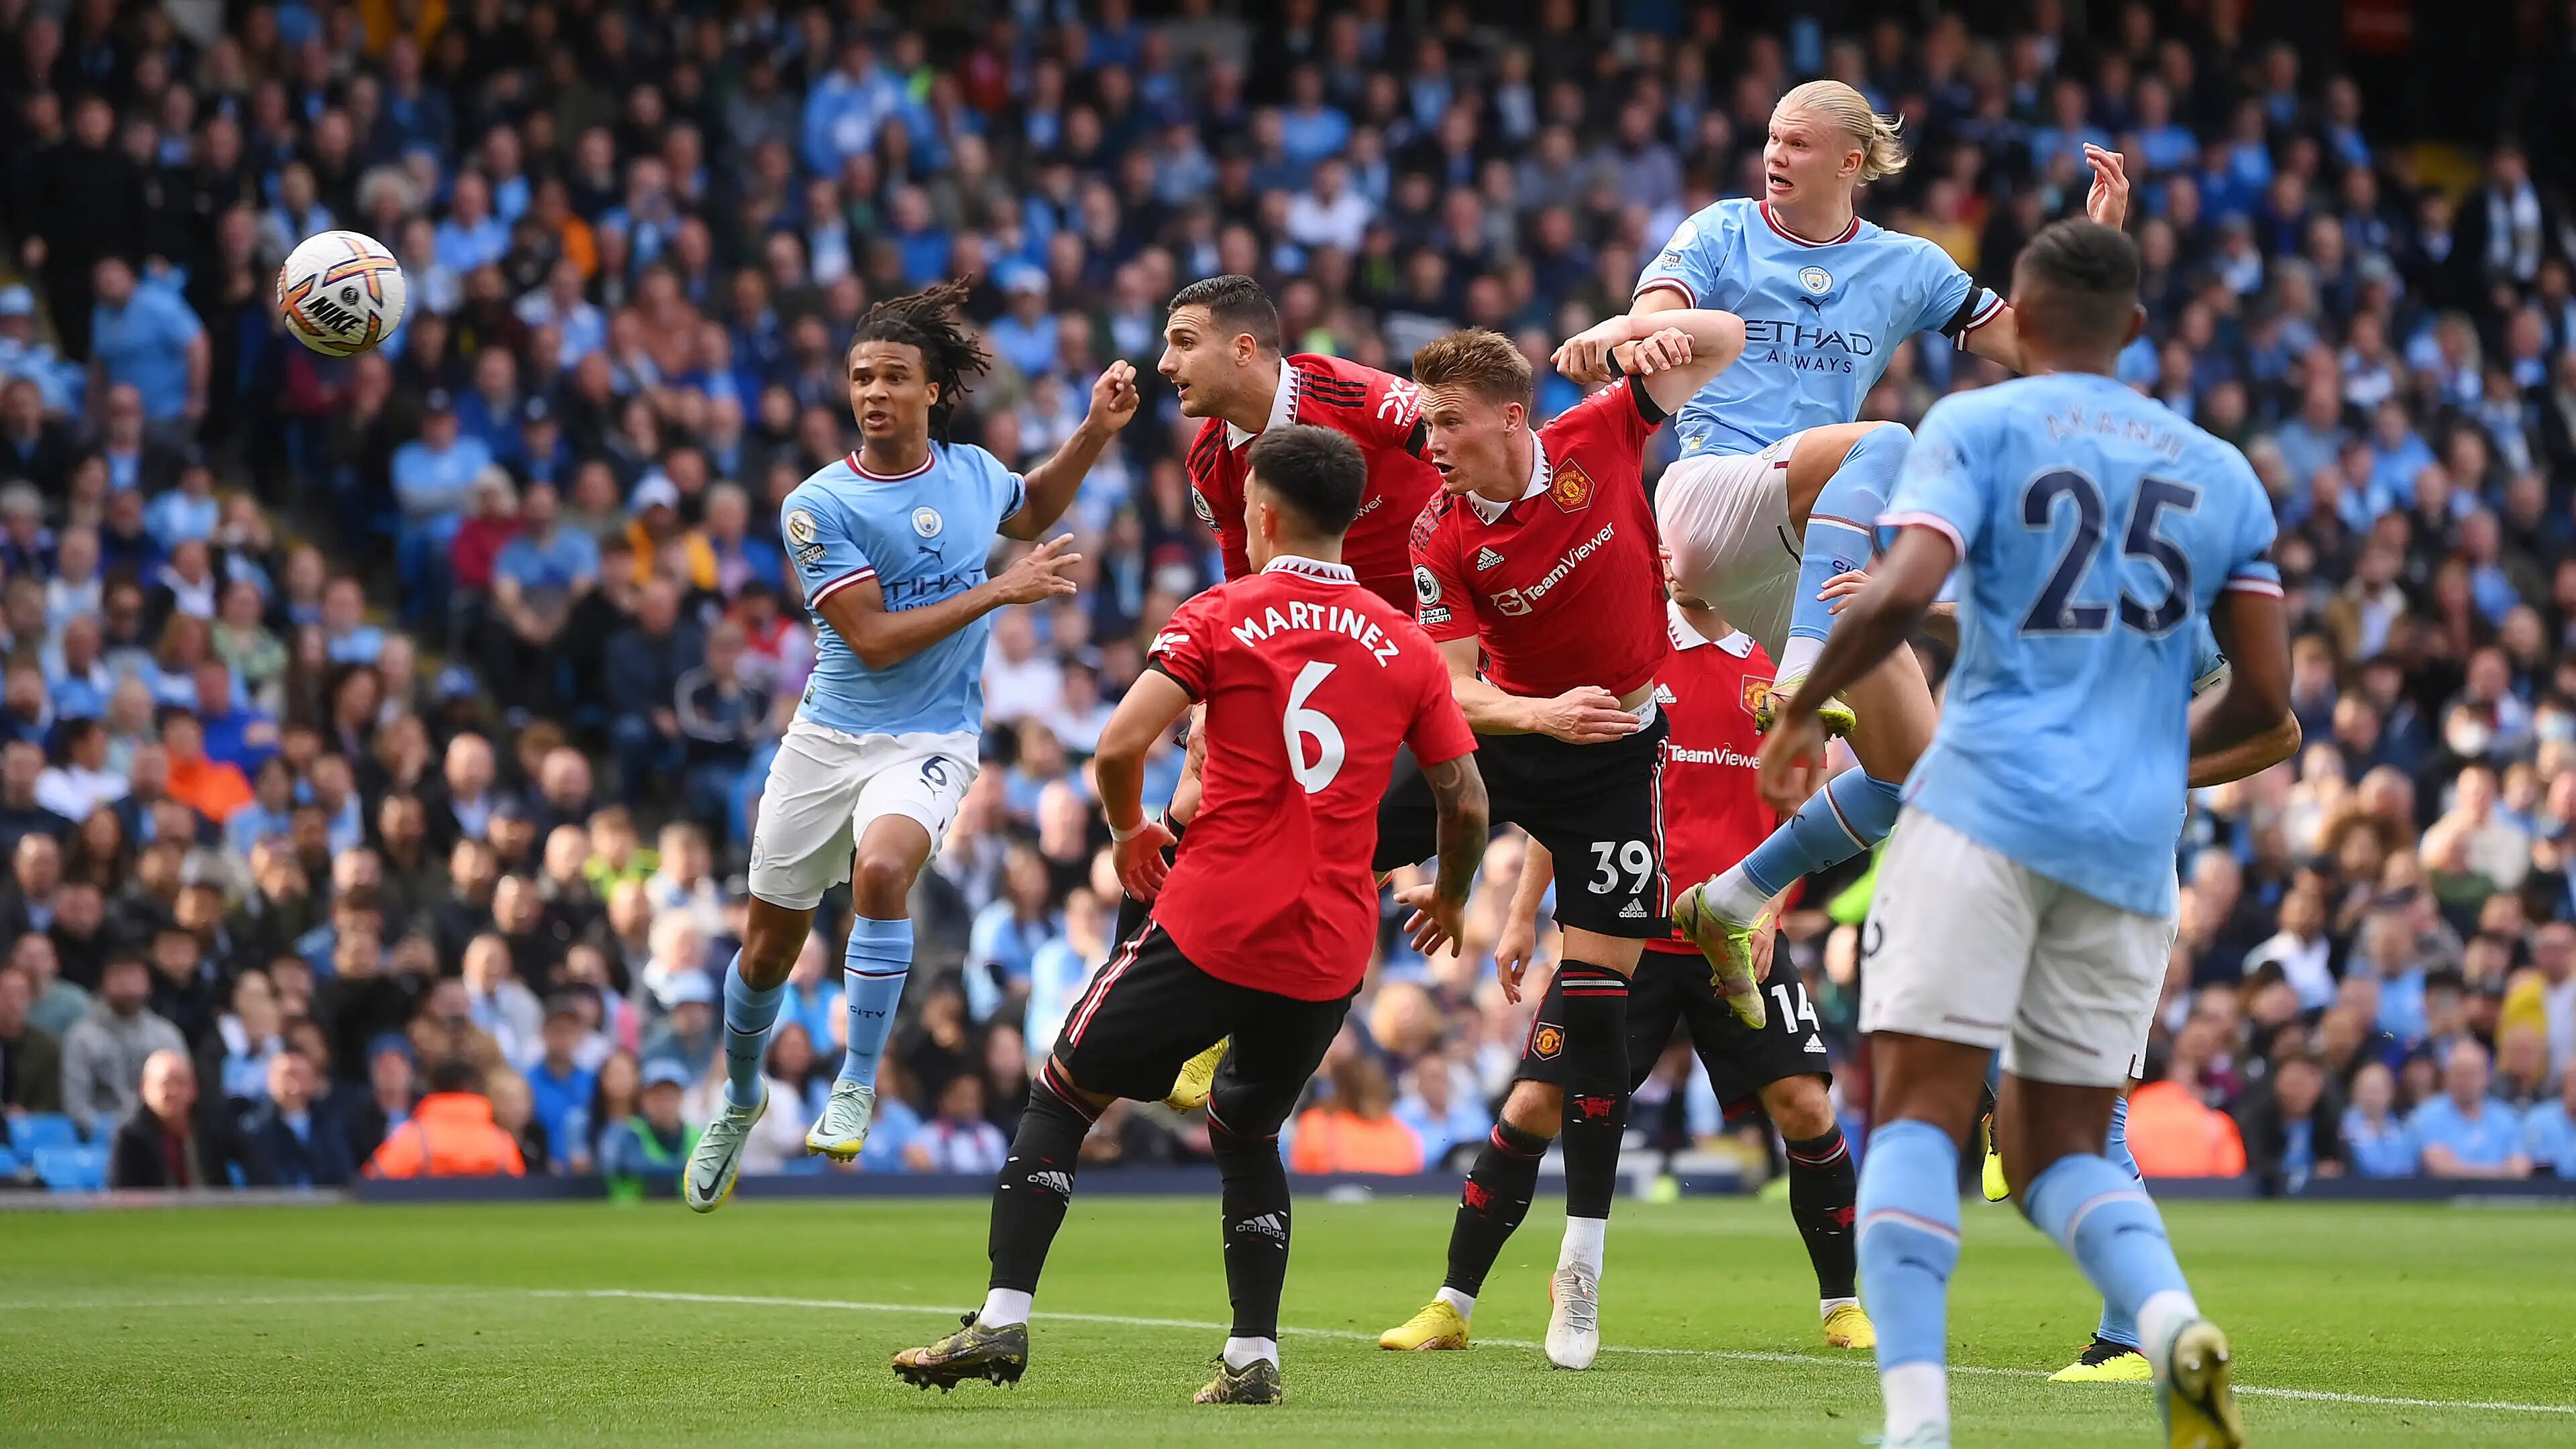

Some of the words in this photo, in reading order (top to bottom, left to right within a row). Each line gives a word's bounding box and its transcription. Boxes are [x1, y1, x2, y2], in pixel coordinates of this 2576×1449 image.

[306, 296, 363, 335] NIKE
[1767, 349, 1852, 374] AIRWAYS
[2046, 405, 2185, 465] AKANJI
[1477, 555, 1505, 571] adidas
[1522, 522, 1615, 600] TeamViewer
[2018, 466, 2203, 640] 25
[1231, 600, 1400, 667] MARTINEZ
[1283, 660, 1346, 794] 6
[922, 755, 951, 786] 6
[1668, 744, 1762, 770] TeamViewe
[1587, 840, 1653, 894] 39
[1771, 982, 1821, 1034] 14
[1236, 1224, 1286, 1240] adidas
